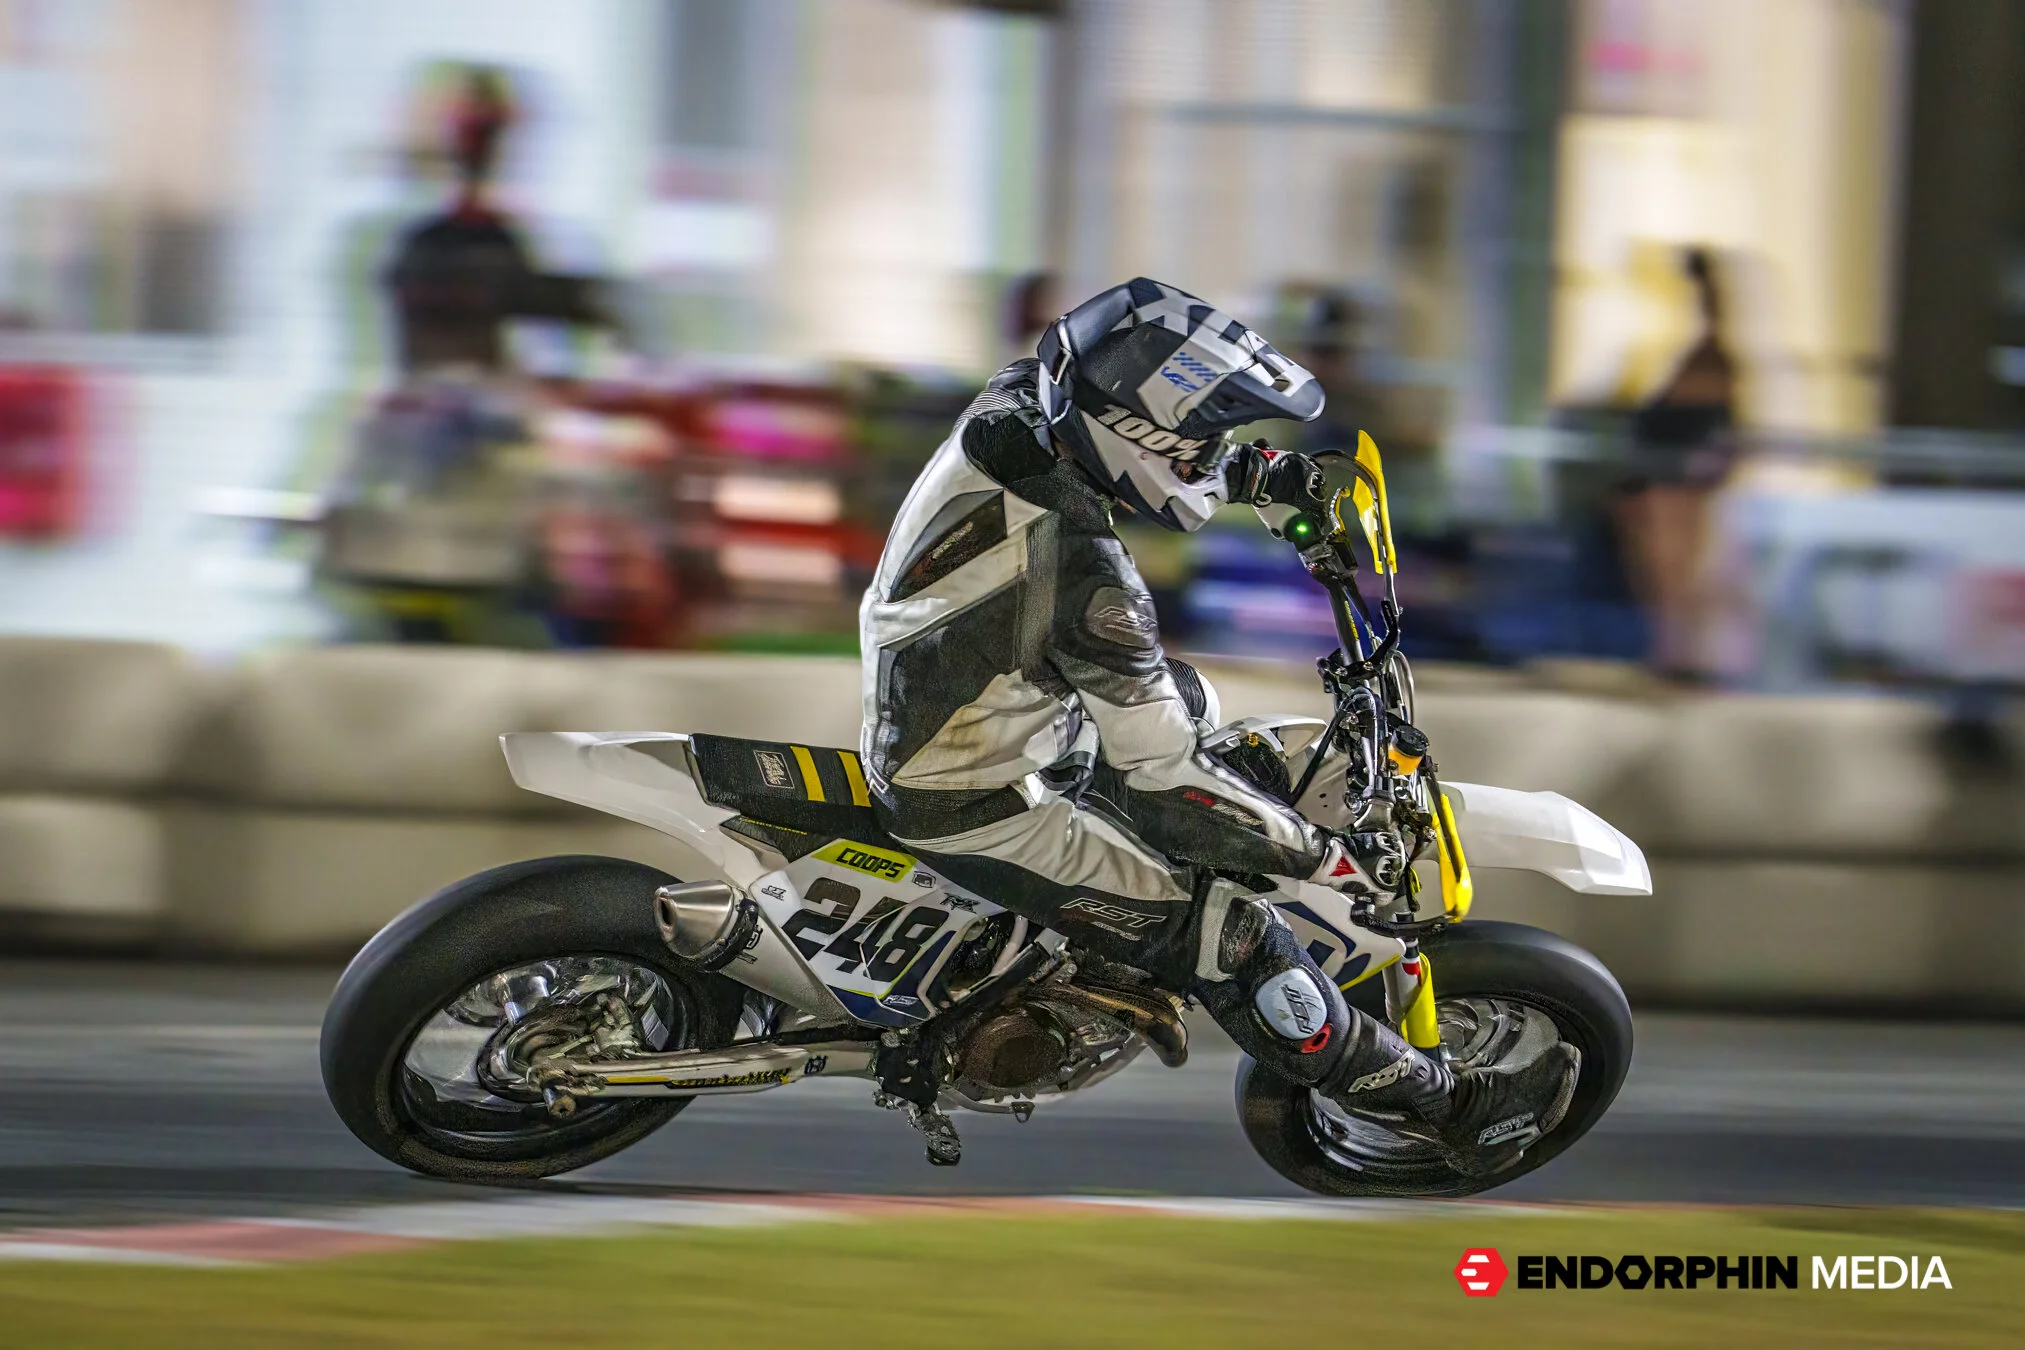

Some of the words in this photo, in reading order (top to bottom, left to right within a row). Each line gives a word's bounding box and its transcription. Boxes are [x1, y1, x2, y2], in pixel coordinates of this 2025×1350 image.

[1097, 404, 1208, 460] 100%
[836, 847, 906, 879] COOPS
[781, 876, 950, 983] 248
[1060, 897, 1167, 928] RST
